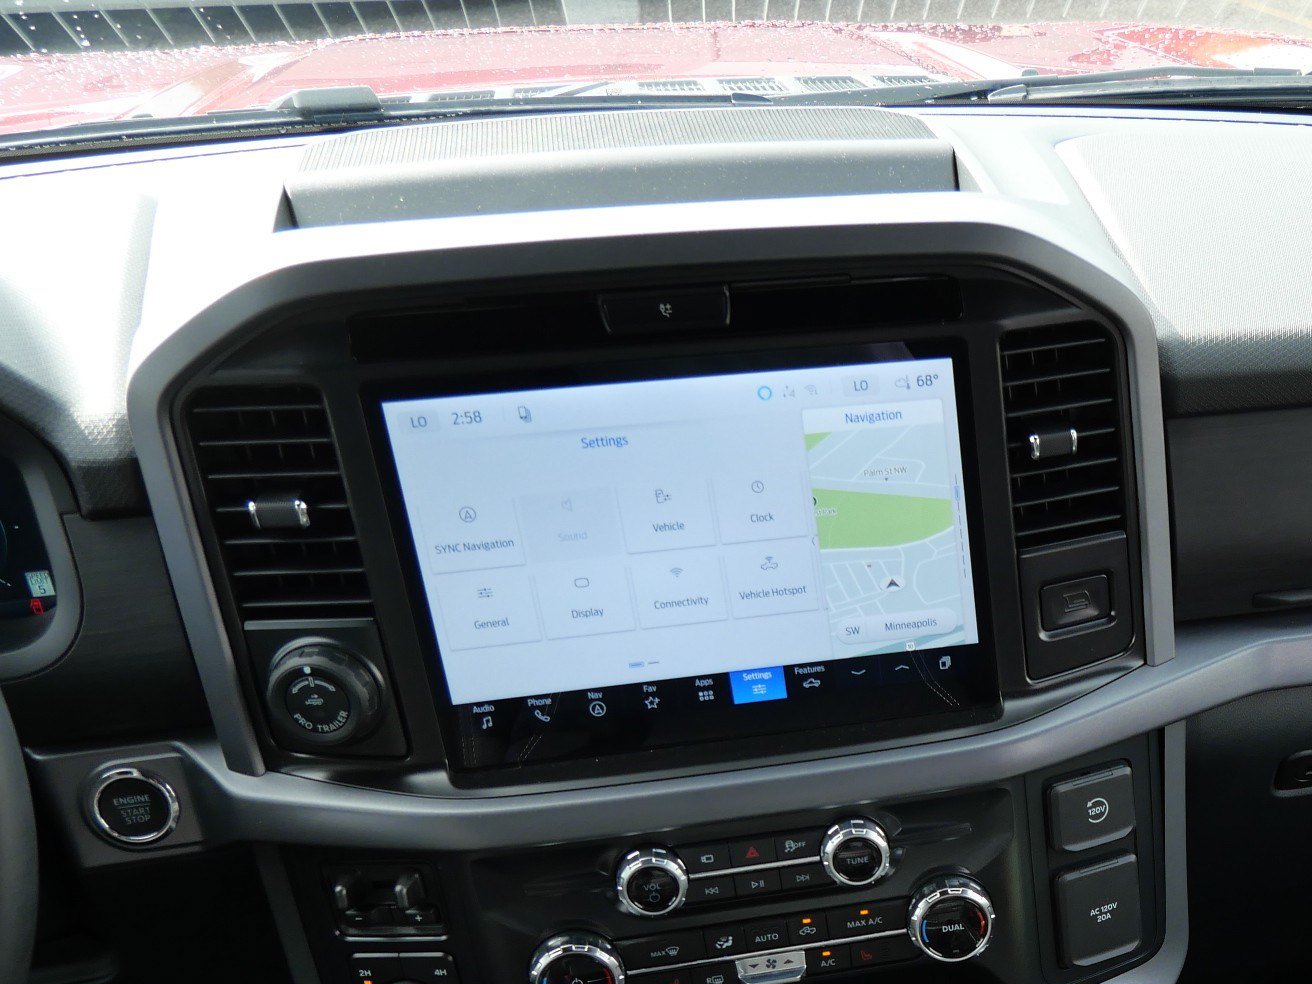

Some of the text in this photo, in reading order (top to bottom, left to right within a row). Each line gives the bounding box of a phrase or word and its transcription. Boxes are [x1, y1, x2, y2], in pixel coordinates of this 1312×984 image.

[854, 380, 869, 392] LO
[916, 374, 939, 387] 68°
[411, 411, 482, 429] LO 2:58
[845, 409, 903, 424] Navigation
[581, 435, 628, 449] Settings
[863, 468, 884, 477] Palm
[894, 466, 907, 475] NW
[750, 512, 774, 523] Clock
[652, 521, 685, 533] Vehicle
[435, 538, 514, 555] SYNC Navigation
[739, 585, 807, 601] Vehicle Hotspot
[654, 596, 709, 610] Connectivity
[571, 607, 604, 620] Display
[474, 617, 510, 630] General
[845, 618, 937, 636] SW Minneapolis
[473, 704, 495, 713] Audio
[527, 696, 552, 707] Phone
[643, 685, 657, 693] Fav
[695, 678, 713, 687] Apps
[742, 670, 772, 681] Settings
[794, 664, 825, 674] Features
[294, 710, 349, 732] PRO TRAILER
[113, 794, 151, 806] ENGINE
[120, 807, 150, 818] START
[1087, 805, 1105, 816] 120V
[125, 814, 150, 825] STOP
[846, 856, 869, 865] TUNE
[643, 883, 661, 891] VOL
[1090, 902, 1118, 916] AC 120V
[847, 916, 883, 929] MAX A/C
[1097, 912, 1111, 922] 20A
[942, 923, 965, 933] DUAL
[755, 933, 778, 944] AUTO
[821, 958, 836, 967] A/C
[359, 969, 371, 977] 2H
